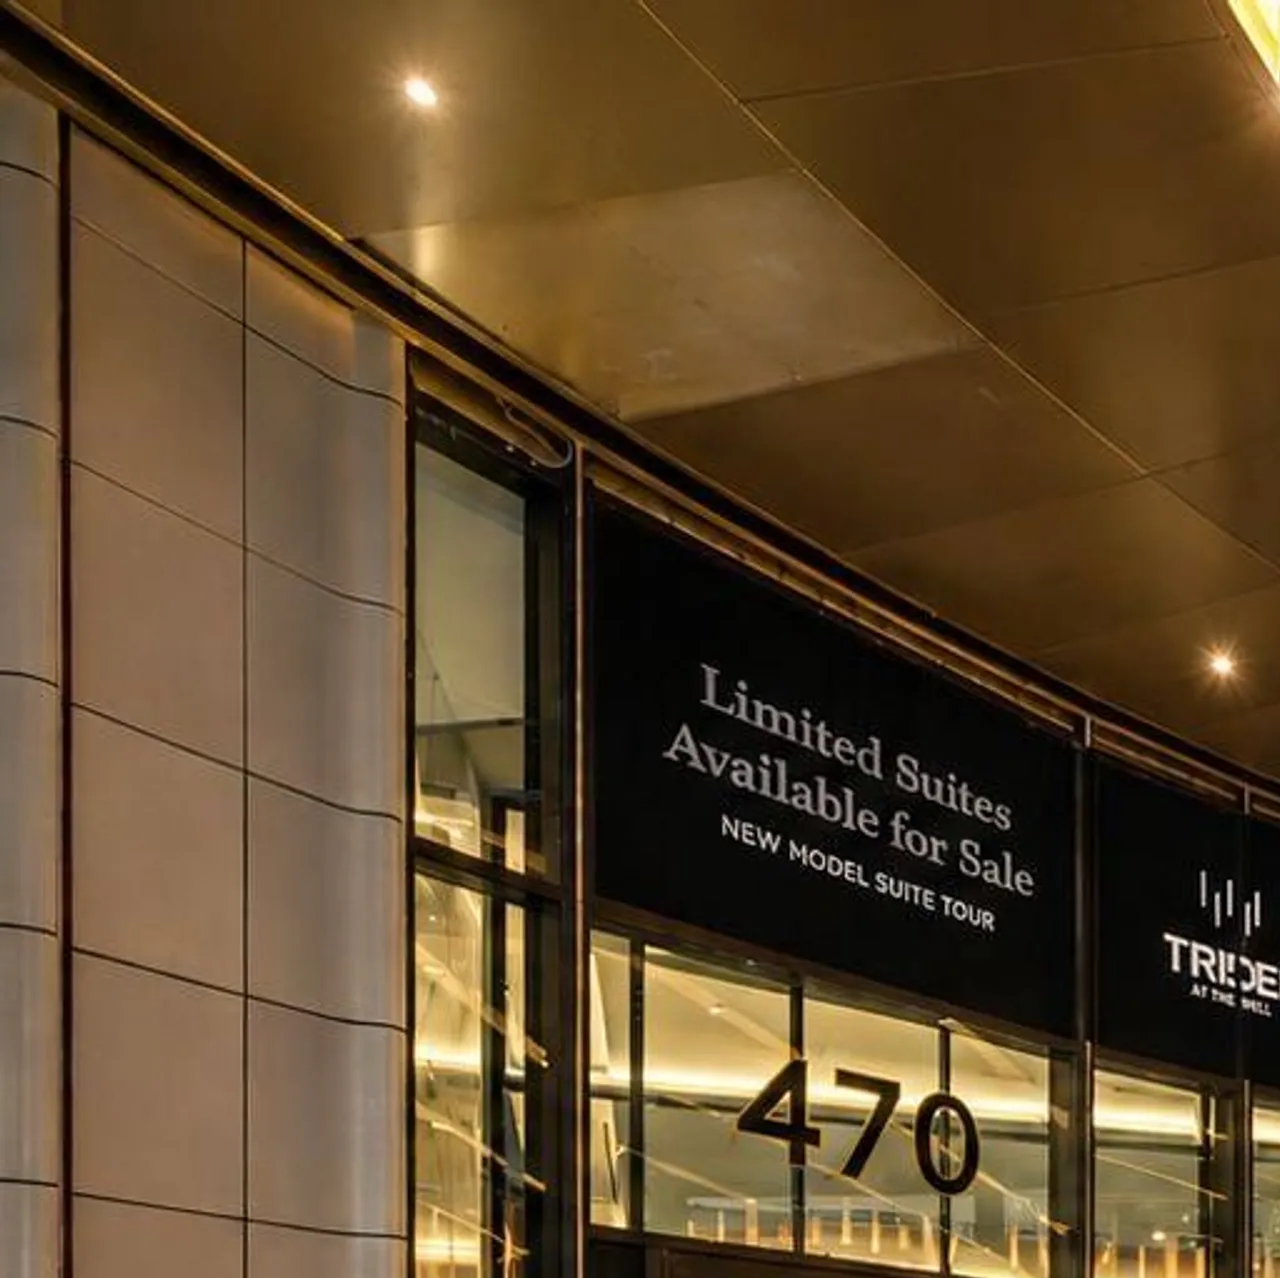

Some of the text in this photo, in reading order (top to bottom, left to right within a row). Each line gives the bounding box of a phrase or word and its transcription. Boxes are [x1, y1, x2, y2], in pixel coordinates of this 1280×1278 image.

[663, 724, 1034, 896] Available for Sale
[700, 663, 1012, 831] Limited Suites
[721, 814, 995, 931] NEW MODEL SUITE TOUR
[1190, 983, 1208, 998] AT
[738, 1058, 979, 1195] 470
